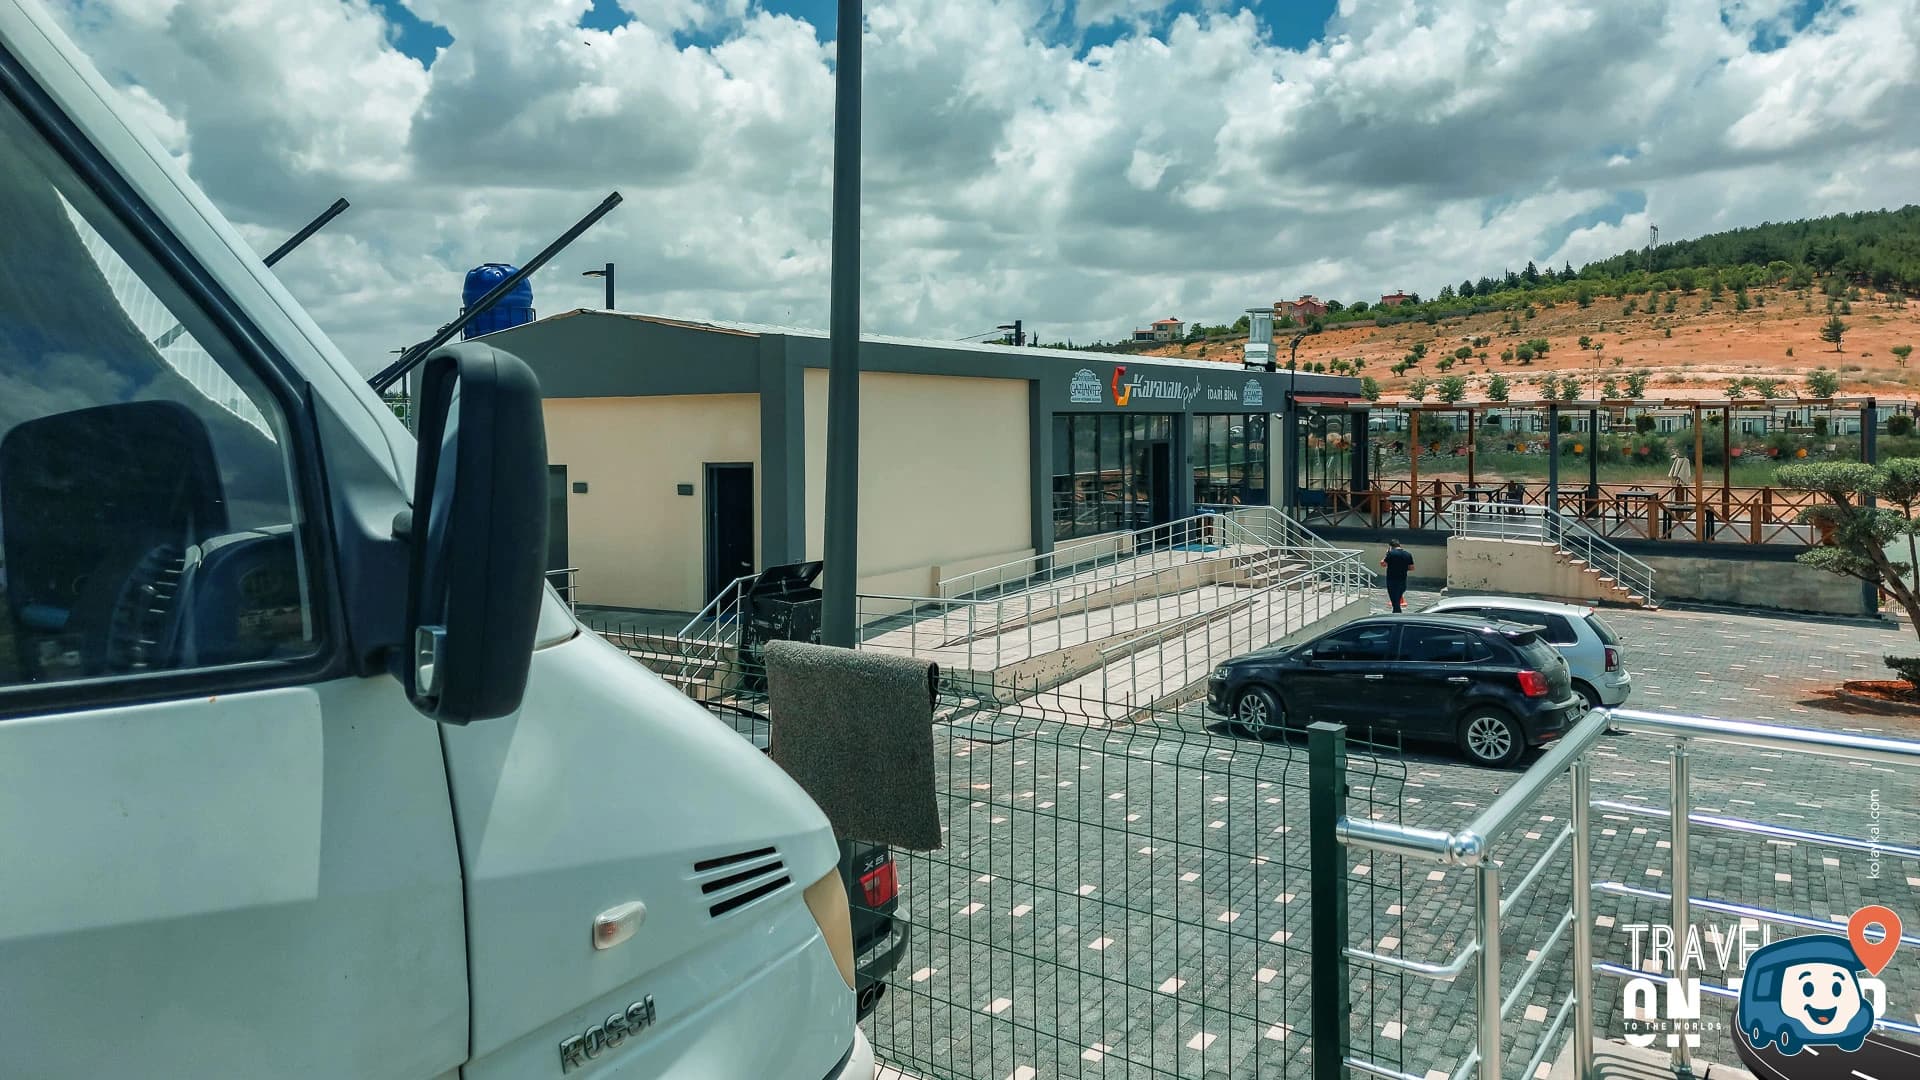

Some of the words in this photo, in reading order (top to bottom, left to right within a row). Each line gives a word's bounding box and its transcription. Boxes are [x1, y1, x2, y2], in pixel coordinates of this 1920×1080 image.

[1132, 373, 1182, 399] Karavan
[1207, 384, 1223, 400] İDARİ
[1224, 386, 1238, 401] BİNA
[559, 993, 657, 1075] ROSSI
